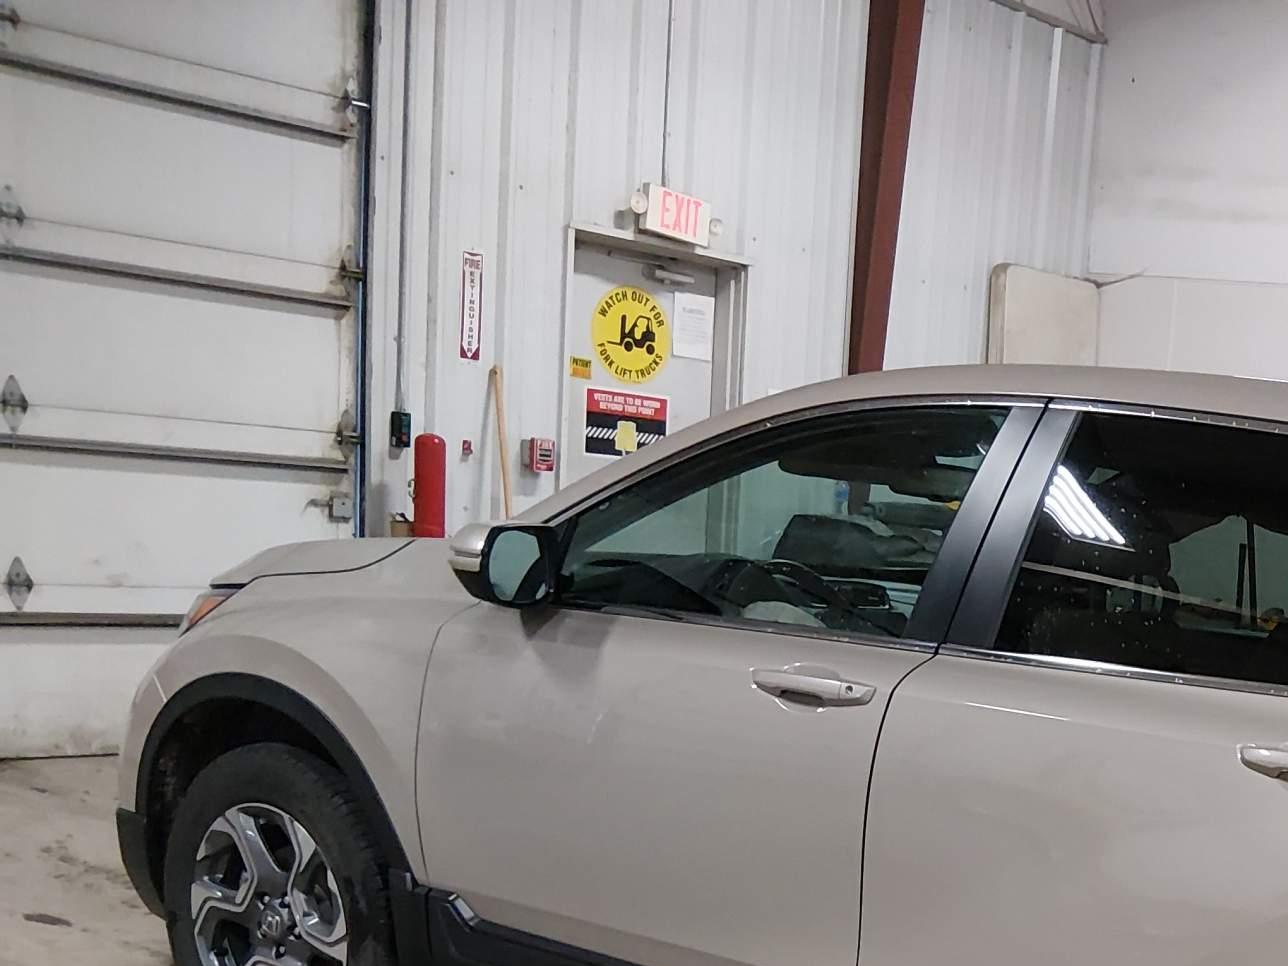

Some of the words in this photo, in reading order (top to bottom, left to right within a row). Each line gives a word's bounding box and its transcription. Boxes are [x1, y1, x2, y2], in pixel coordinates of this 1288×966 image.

[661, 190, 702, 238] EXIT
[464, 257, 481, 270] FIRE
[466, 271, 475, 353] EXTINGUISHER
[598, 290, 628, 318] WATCH
[631, 291, 650, 306] OUT
[649, 305, 664, 328] FOR
[597, 342, 615, 369] FORK
[614, 365, 632, 379] LIFT
[634, 353, 663, 380] TRUCKS
[593, 393, 613, 402] VESTS
[614, 395, 625, 405] ARE
[626, 397, 634, 405] TO
[599, 402, 623, 411] BEYOND
